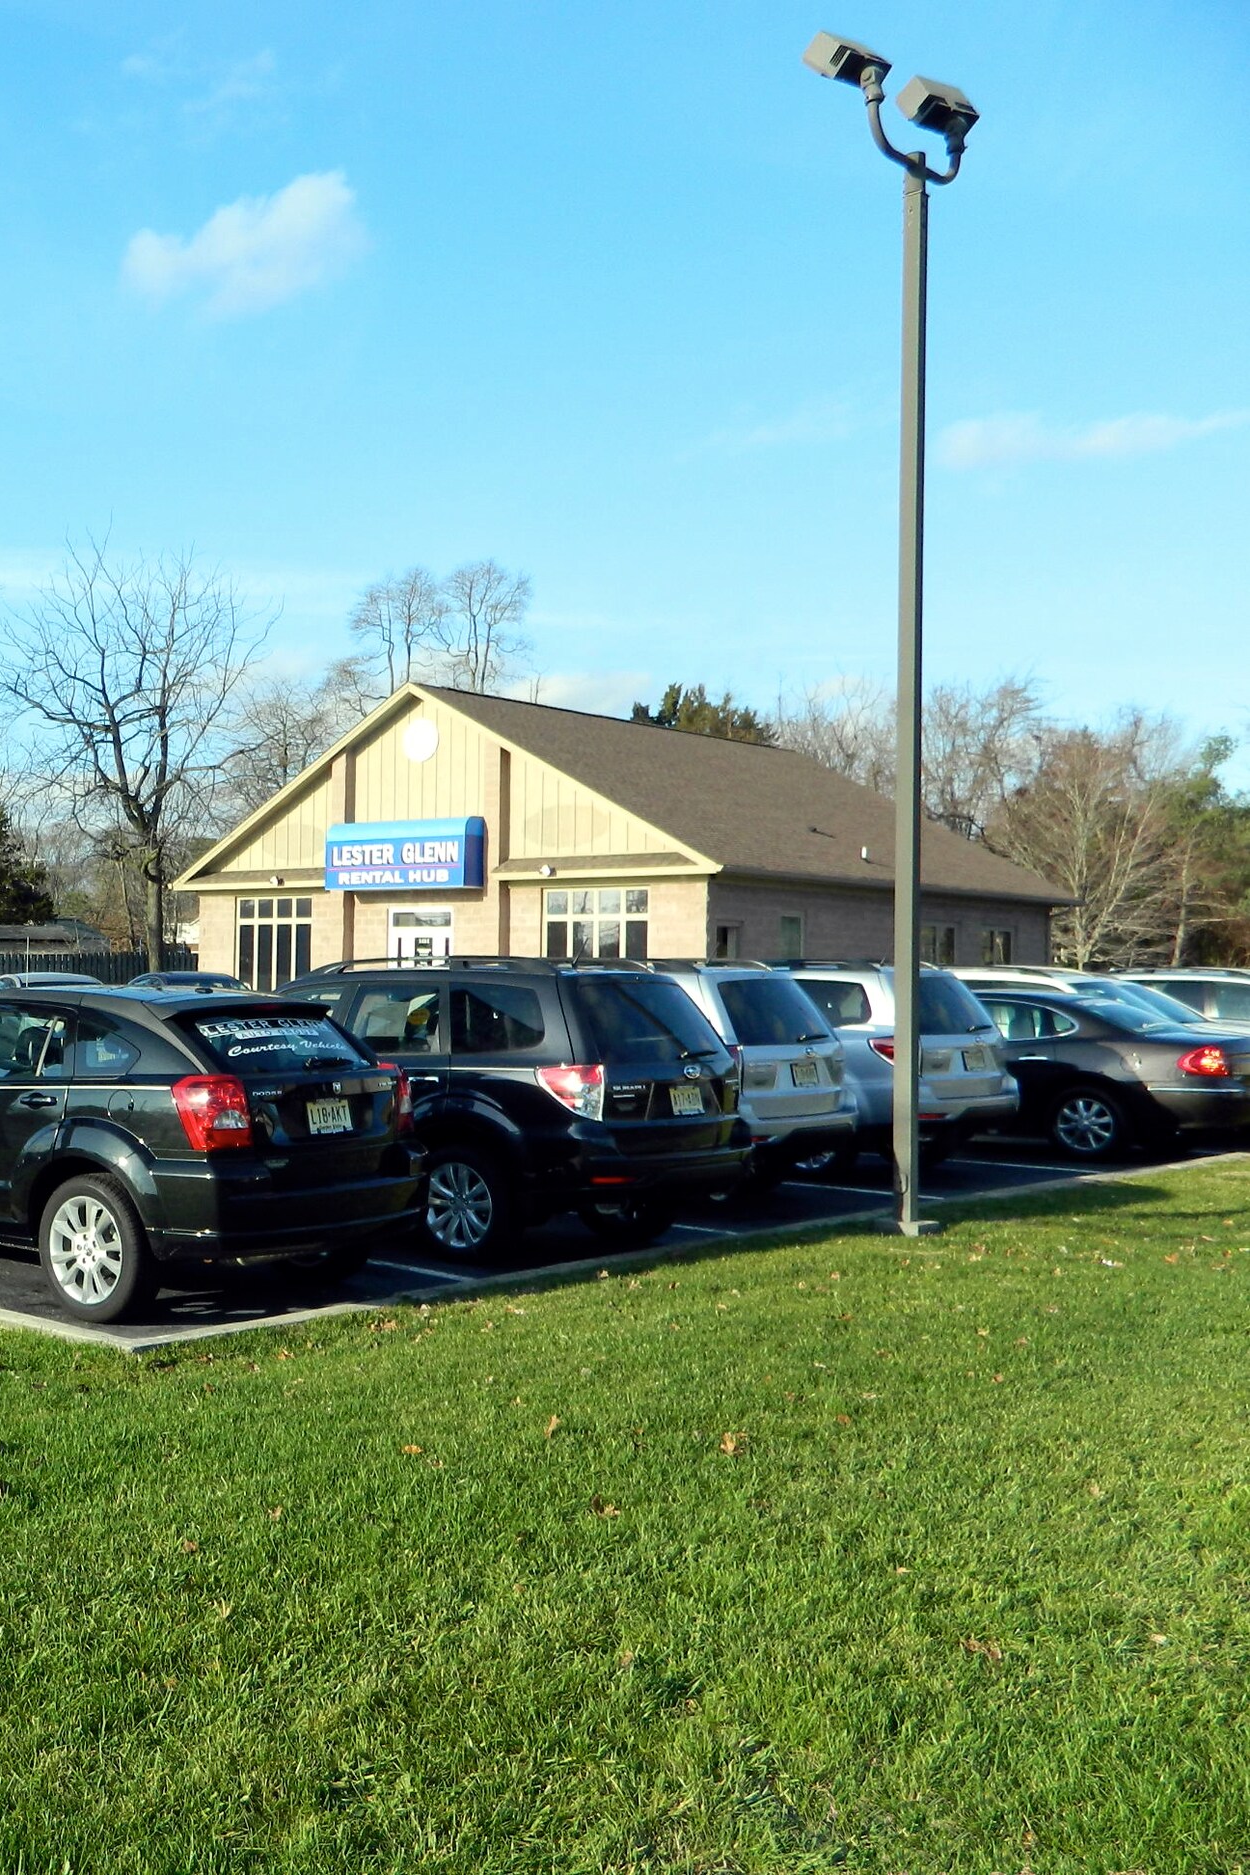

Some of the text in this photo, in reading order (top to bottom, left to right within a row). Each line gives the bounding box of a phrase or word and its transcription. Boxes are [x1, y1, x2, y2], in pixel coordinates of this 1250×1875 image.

[332, 841, 459, 867] LESTER GLENN
[338, 869, 449, 885] RENTAL HUB
[203, 1019, 272, 1036] LESTER
[227, 1043, 298, 1057] Courtesy
